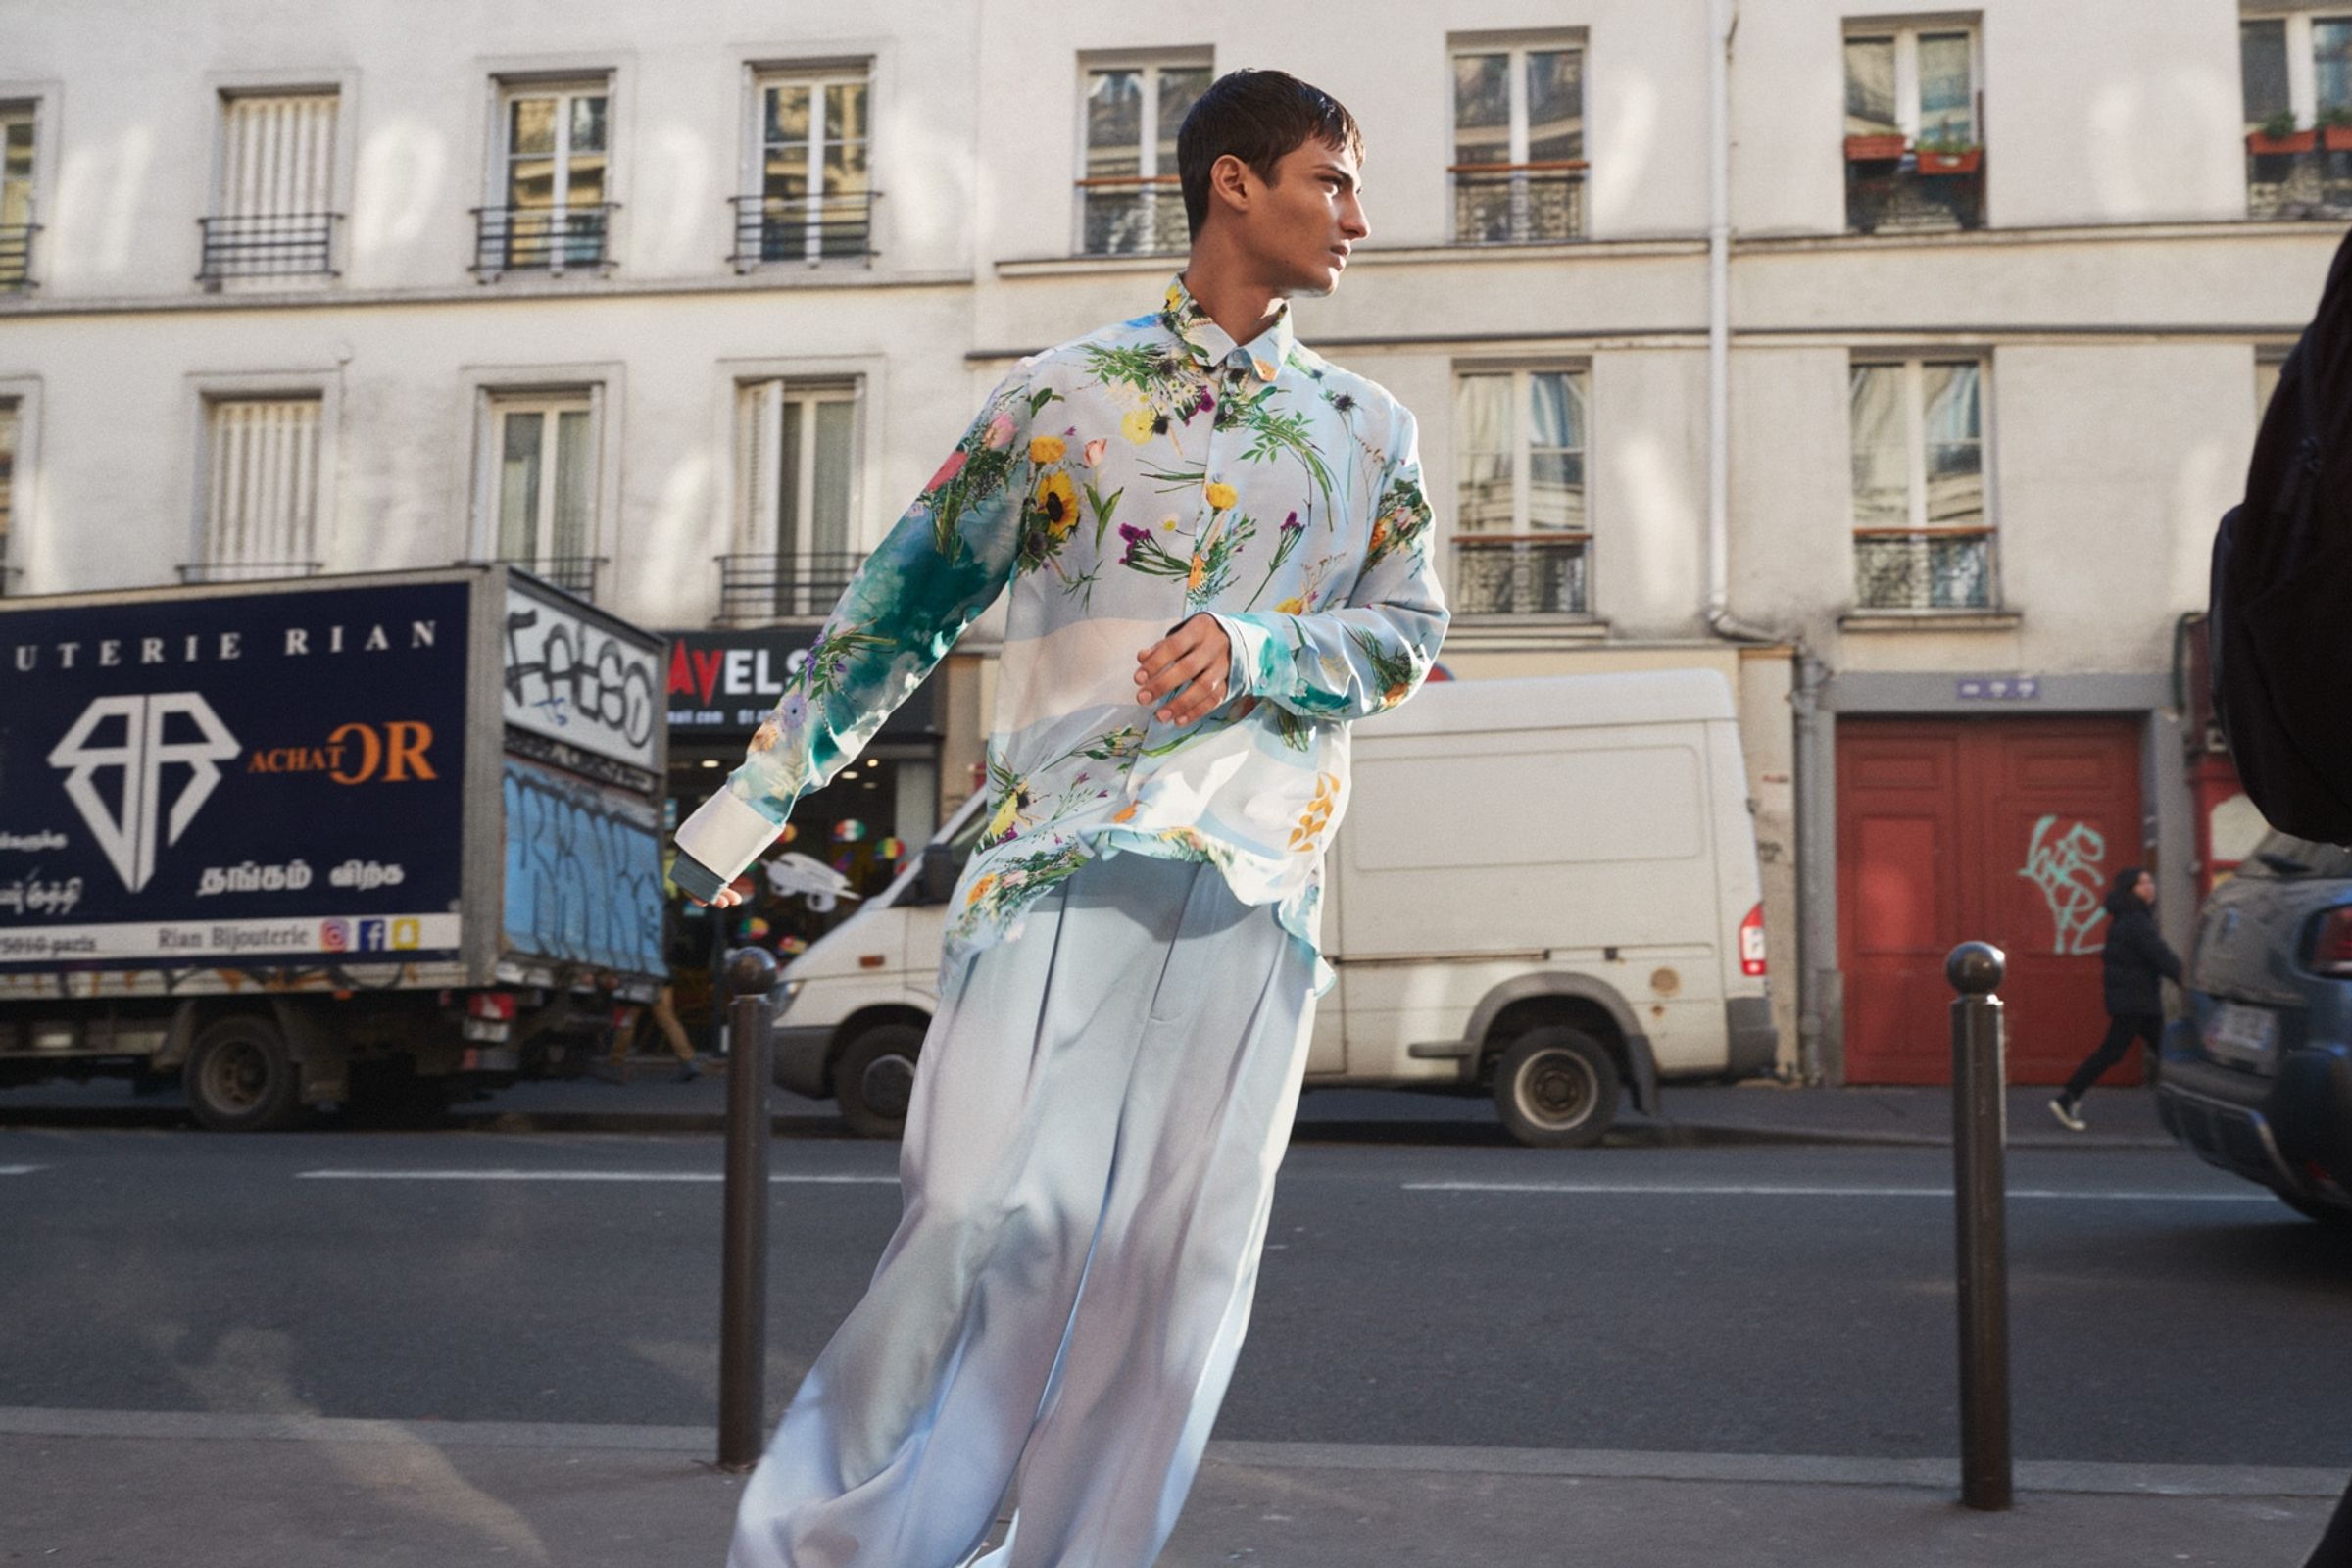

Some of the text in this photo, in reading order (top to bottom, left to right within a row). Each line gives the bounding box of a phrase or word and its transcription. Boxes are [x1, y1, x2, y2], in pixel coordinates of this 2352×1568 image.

[15, 620, 437, 671] UTERIE RIAN
[247, 720, 438, 785] ACHAT OR
[158, 924, 310, 952] Rian Bijouterie
